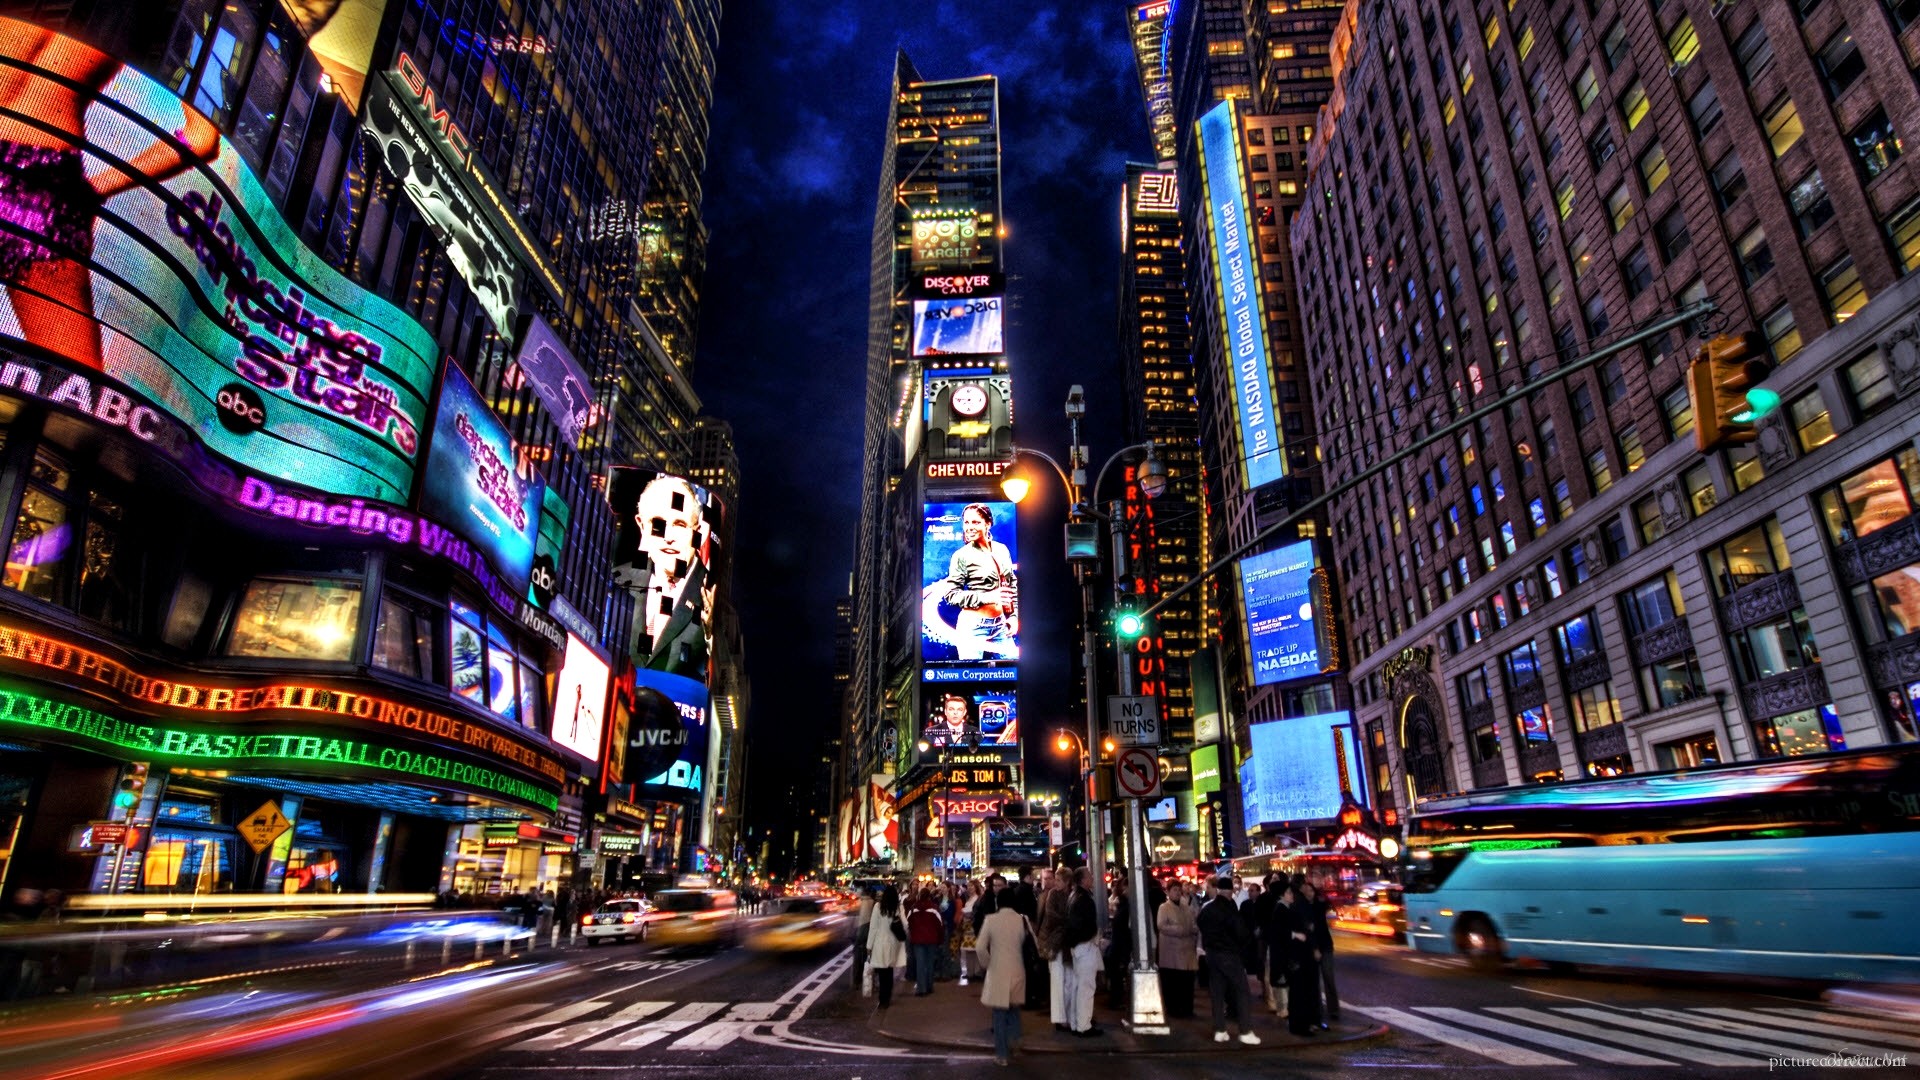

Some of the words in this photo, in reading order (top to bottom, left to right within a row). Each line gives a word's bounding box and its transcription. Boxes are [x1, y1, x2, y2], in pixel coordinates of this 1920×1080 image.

[398, 52, 469, 162] GMC
[388, 97, 401, 120] THE
[400, 116, 416, 137] NEW
[414, 131, 430, 156] 2007
[430, 153, 473, 214] YUKON
[473, 212, 515, 272] DENALI
[1220, 199, 1241, 253] Market
[919, 247, 972, 260] TARGET
[924, 275, 990, 289] DISCOVER
[941, 285, 974, 295] CARD
[1228, 255, 1247, 307] Select
[1234, 304, 1255, 358] Global
[362, 375, 400, 409] with
[1241, 355, 1266, 428] NASDAQ
[49, 372, 161, 442] ABC
[216, 387, 265, 426] abc
[455, 412, 510, 488] dancing
[1253, 428, 1270, 464] The
[239, 475, 413, 544] Dancing
[418, 516, 472, 573] With
[1256, 645, 1285, 659] TRADE
[1286, 643, 1299, 653] UP
[936, 670, 960, 680] News
[962, 669, 1015, 681] Corporation
[207, 684, 323, 711] RECALL
[378, 700, 462, 742] INCLUDE
[462, 724, 490, 750] DRY
[982, 709, 1005, 719] 80
[1121, 702, 1143, 718] NO
[1112, 718, 1156, 735] TURNS
[27, 695, 155, 752] WOMEN'S
[160, 729, 376, 767] BASKETBALL
[379, 747, 451, 780] COACH
[451, 761, 499, 792] POKEY
[630, 729, 672, 748] JVC
[938, 753, 1002, 764] Pnasonic
[973, 770, 994, 783] TOM
[1275, 808, 1292, 820] ALL
[1295, 806, 1325, 819] ADDS
[252, 826, 274, 834] SHARE
[251, 838, 270, 846] ROAD
[604, 842, 633, 850] COFFEE
